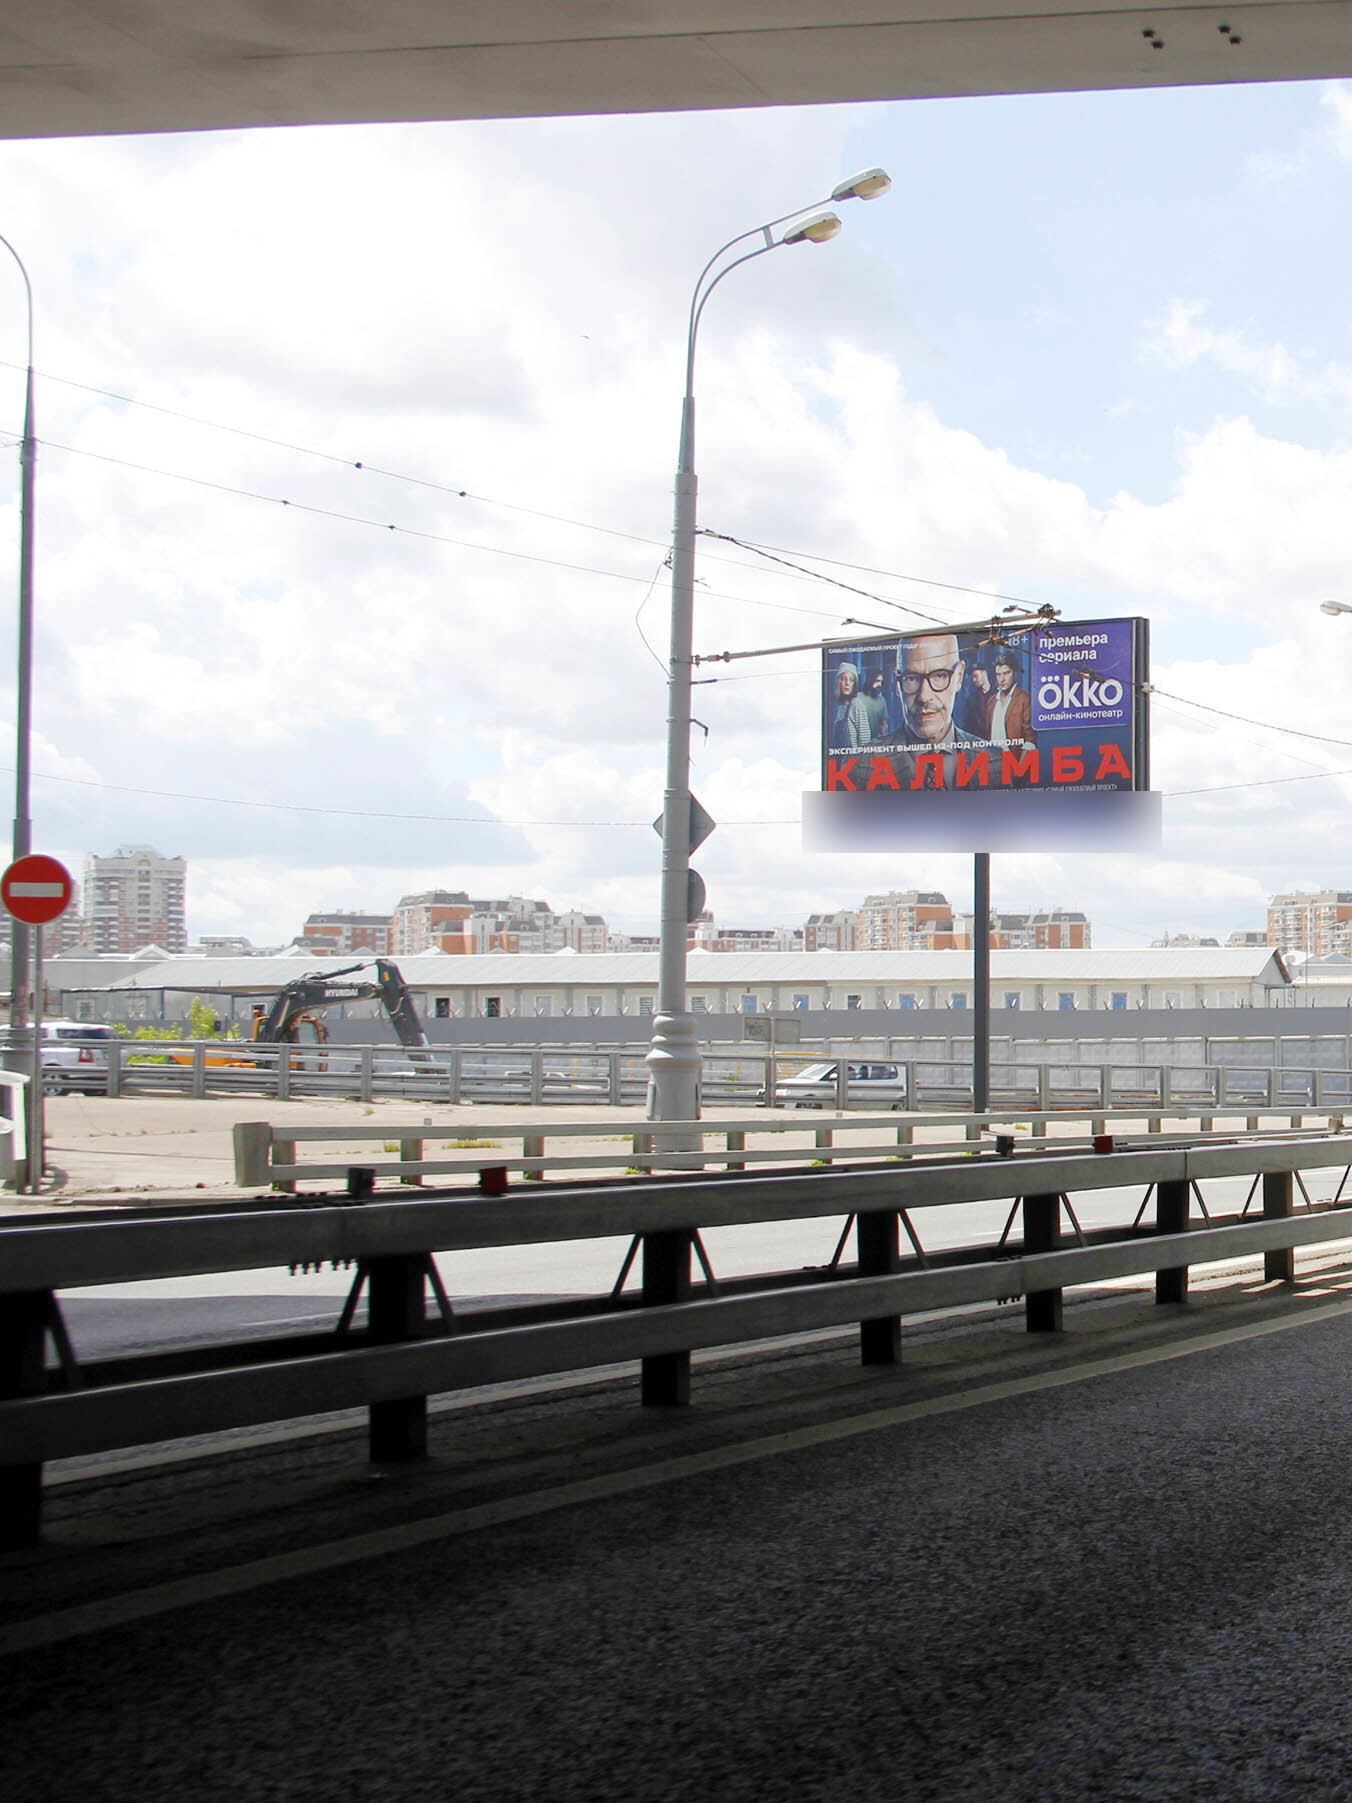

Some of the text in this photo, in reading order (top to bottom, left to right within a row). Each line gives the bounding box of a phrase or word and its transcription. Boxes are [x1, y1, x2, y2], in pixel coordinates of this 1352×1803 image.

[1040, 633, 1108, 650] премьера
[1039, 649, 1097, 664] сериала
[1038, 709, 1123, 722] онлайн-кинотеатр
[828, 738, 1024, 756] ЭКСПЕРИМЕНТ ВЫШЕЛ ИЗ-ПОД КОНТРОЛЯ
[827, 744, 1131, 791] КАЛИМБА
